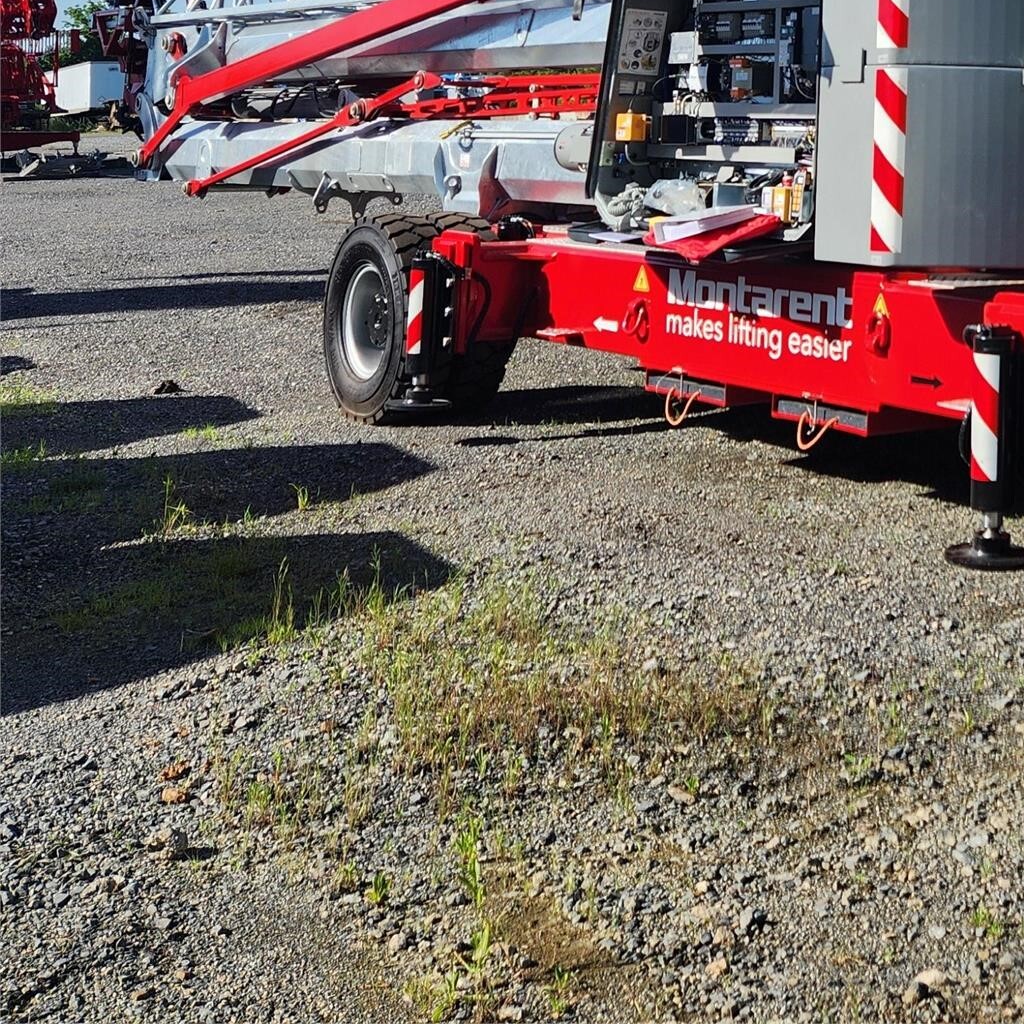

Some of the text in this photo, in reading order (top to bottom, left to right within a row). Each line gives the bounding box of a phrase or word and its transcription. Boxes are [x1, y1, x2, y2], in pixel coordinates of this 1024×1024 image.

[667, 268, 853, 328] Montarent
[666, 310, 852, 362] makes lifting easier
